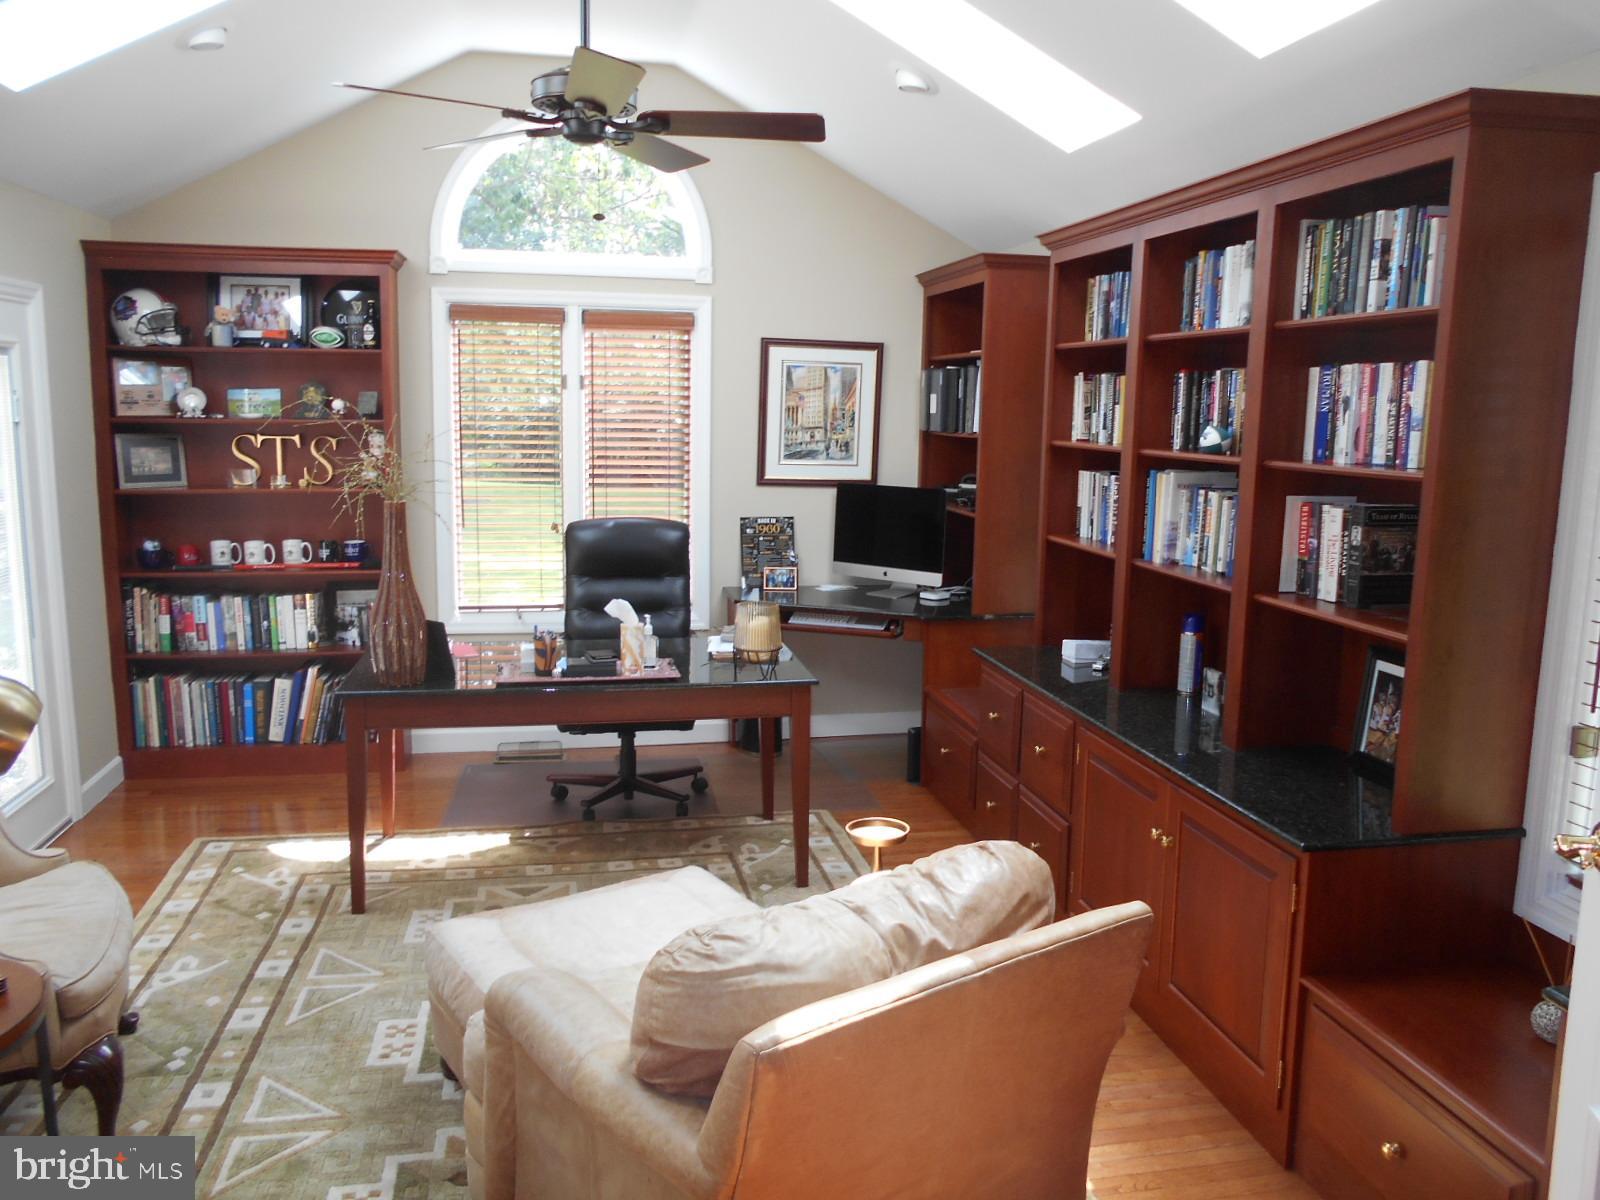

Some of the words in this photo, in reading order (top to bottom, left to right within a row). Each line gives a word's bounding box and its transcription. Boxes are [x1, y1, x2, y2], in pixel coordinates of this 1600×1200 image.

[1320, 370, 1332, 412] TRUMAN
[1298, 506, 1309, 553] WASHINGTON
[1341, 530, 1350, 576] ABRAHAM
